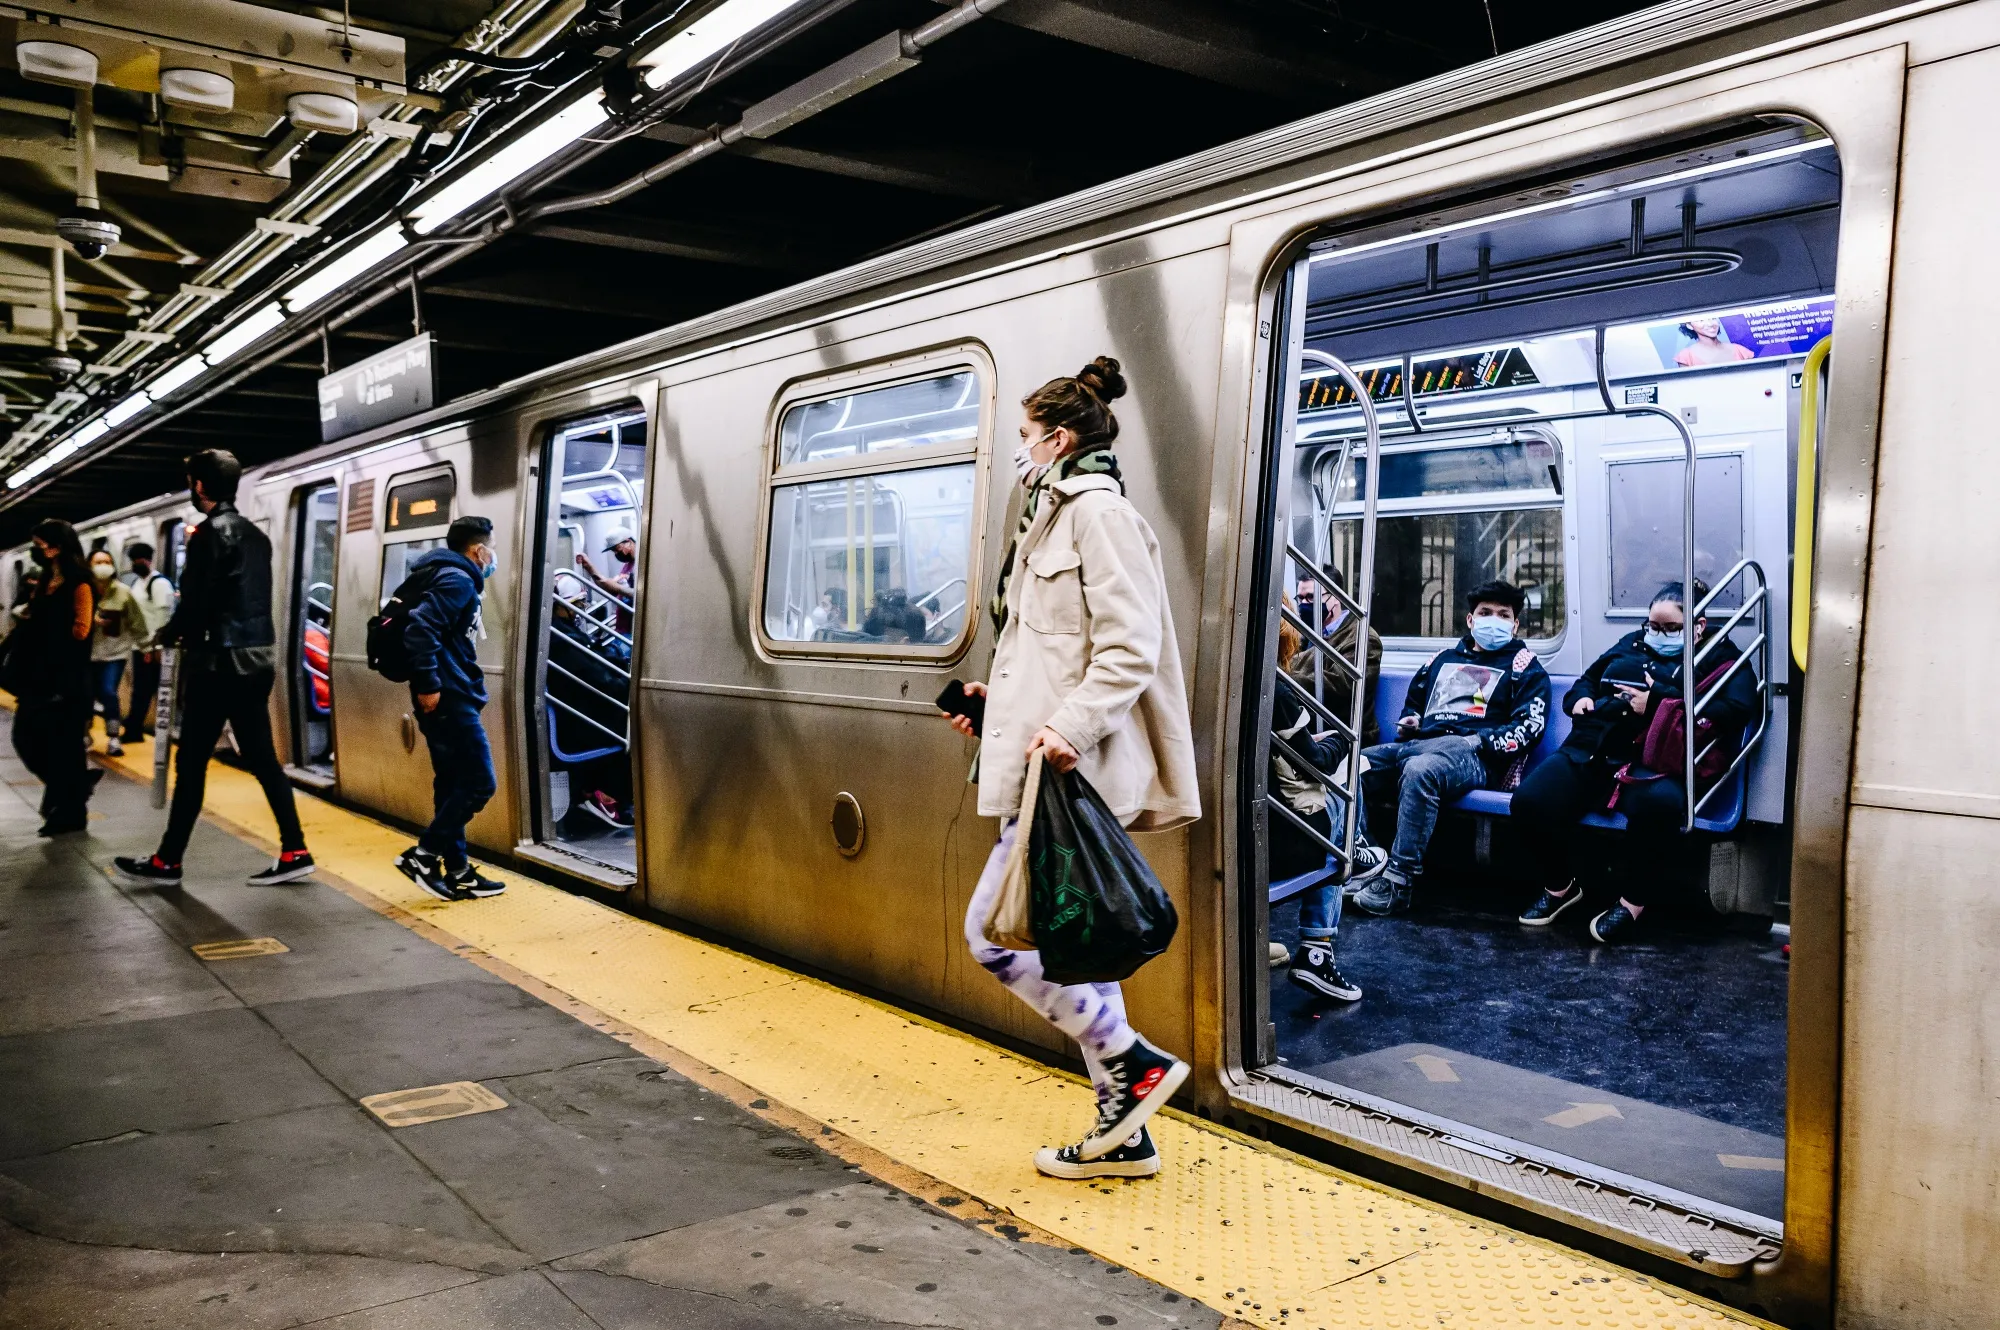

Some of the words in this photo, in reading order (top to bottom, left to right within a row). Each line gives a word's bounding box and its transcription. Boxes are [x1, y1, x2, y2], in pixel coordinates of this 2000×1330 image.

[1768, 312, 1805, 323] understand
[1805, 310, 1820, 319] how
[1820, 309, 1834, 317] you
[1750, 322, 1792, 333] prescriptions
